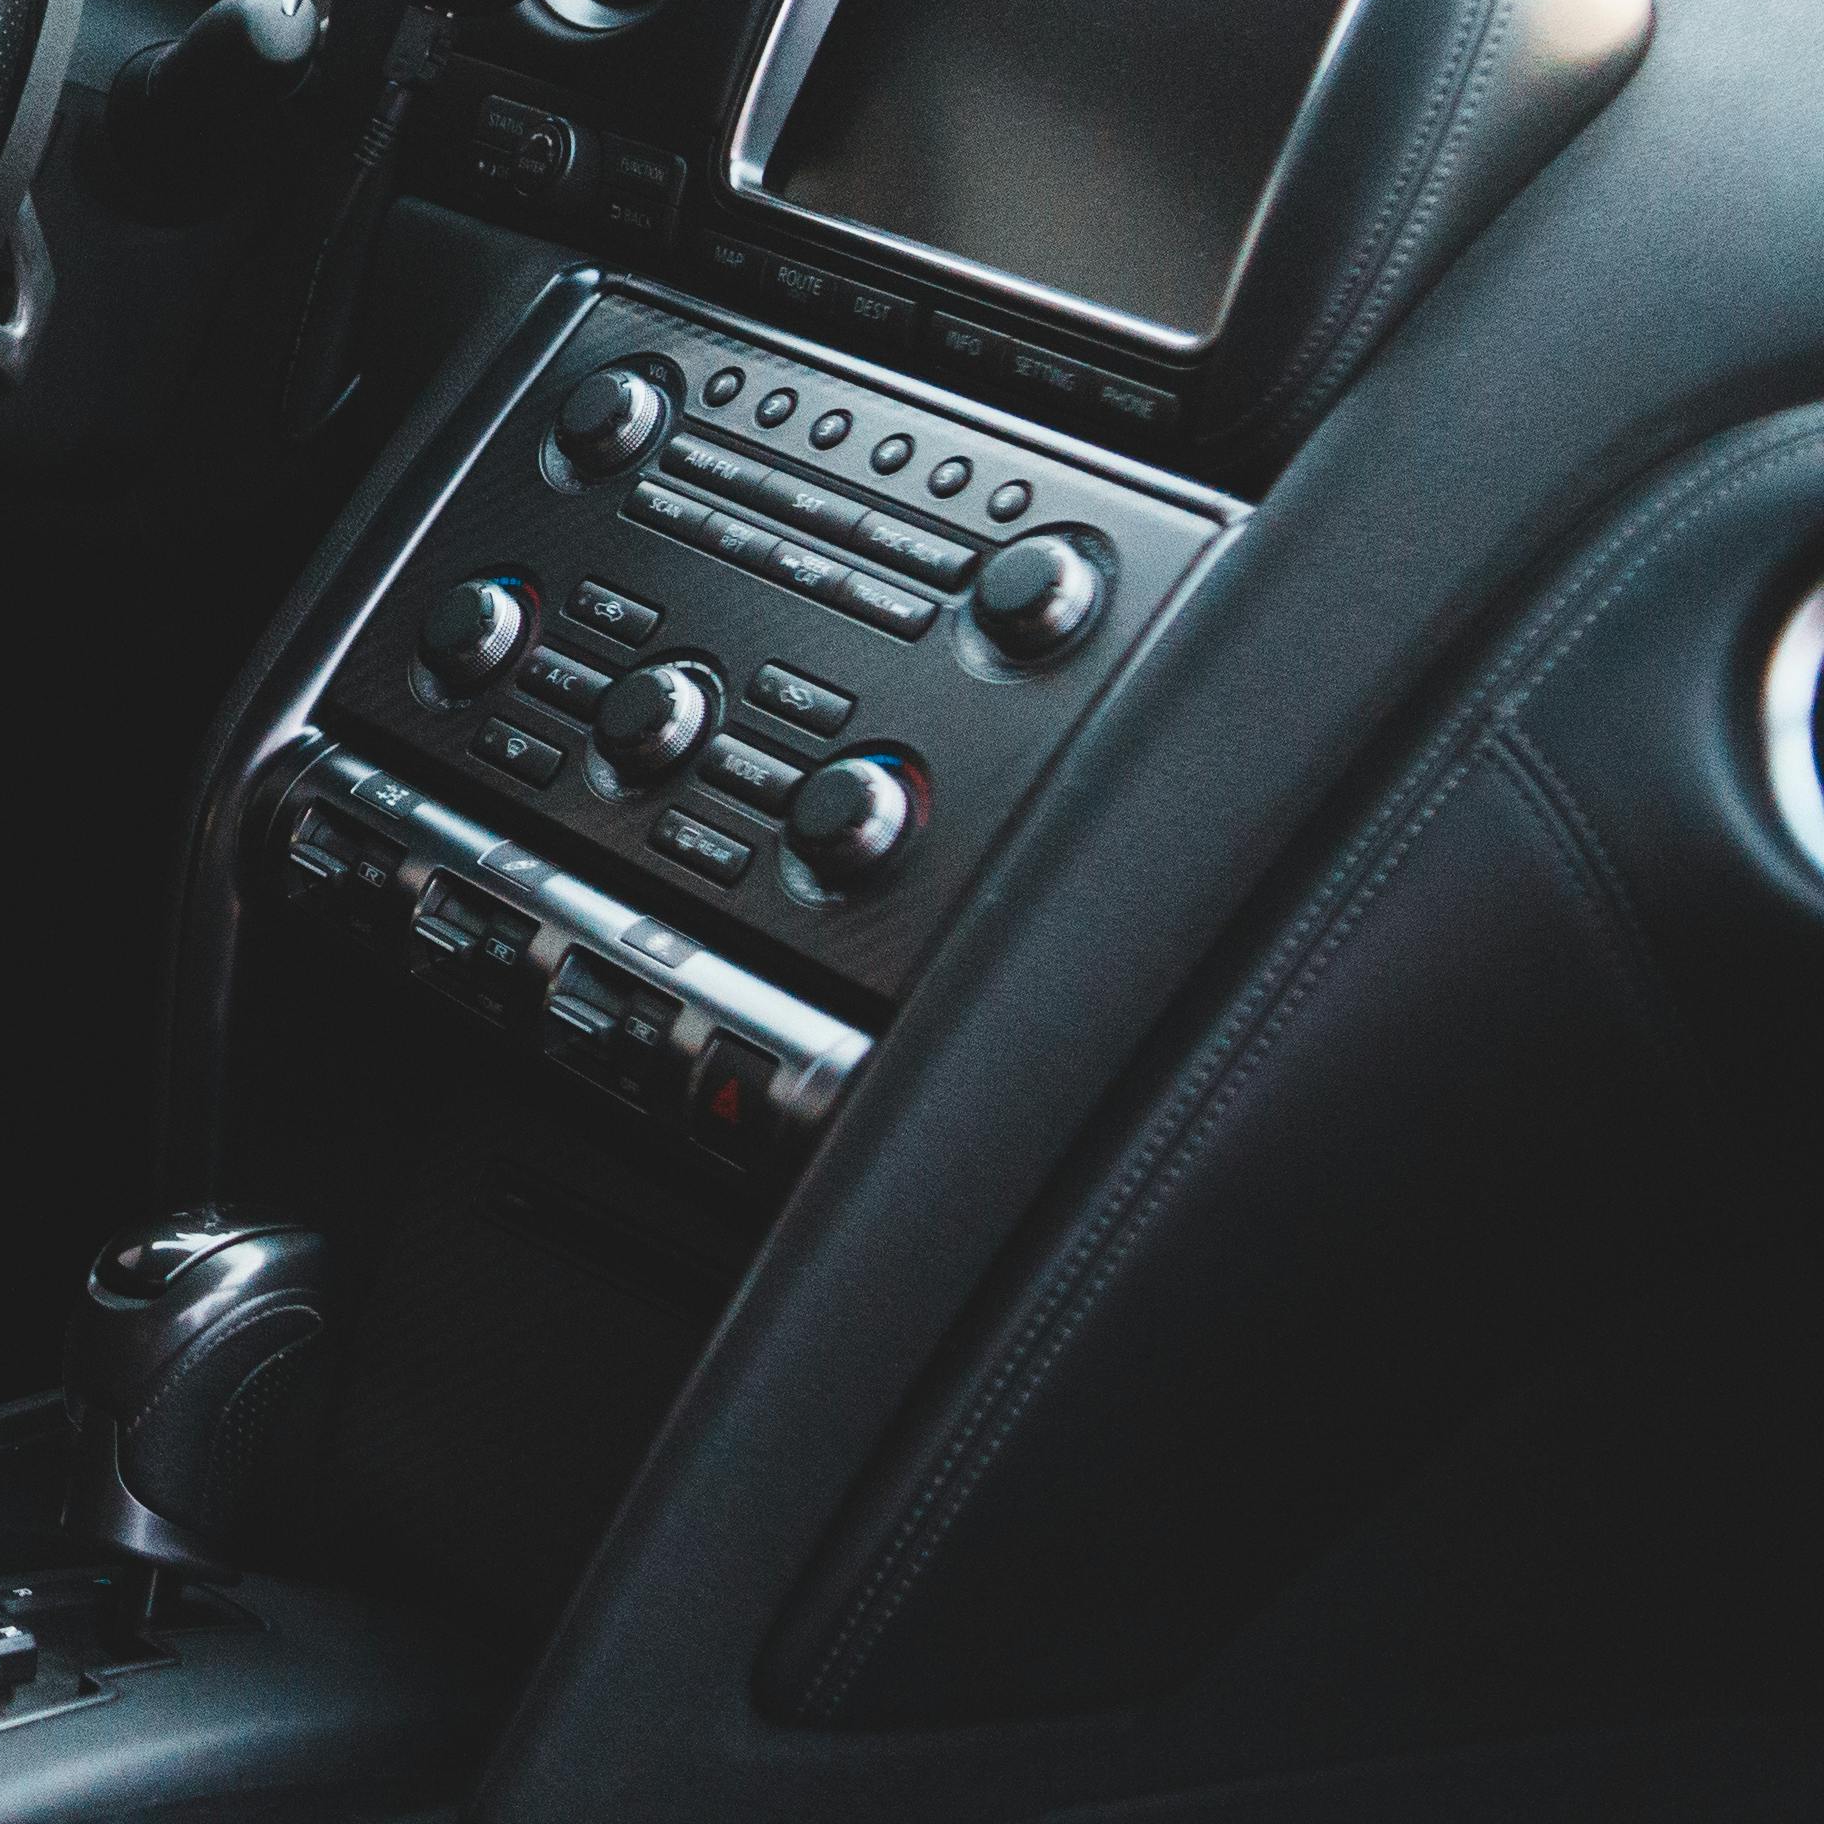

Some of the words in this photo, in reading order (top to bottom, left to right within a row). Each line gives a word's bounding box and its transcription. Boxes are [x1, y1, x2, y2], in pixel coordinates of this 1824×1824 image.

[714, 245, 745, 268] MAP
[776, 265, 824, 297] ROUTE
[852, 295, 893, 321] DEST
[945, 330, 983, 357] INFO
[649, 364, 668, 382] VOL
[1014, 355, 1076, 392] SETTING
[763, 399, 780, 415] 2
[1102, 385, 1156, 420] PHONE
[818, 420, 837, 436] 3
[649, 498, 684, 519] SCAN
[792, 493, 827, 514] SAT
[545, 667, 578, 691] A/C
[723, 753, 770, 787] MODE
[698, 838, 734, 865] REAR
[365, 865, 380, 883] R
[494, 942, 510, 962] R
